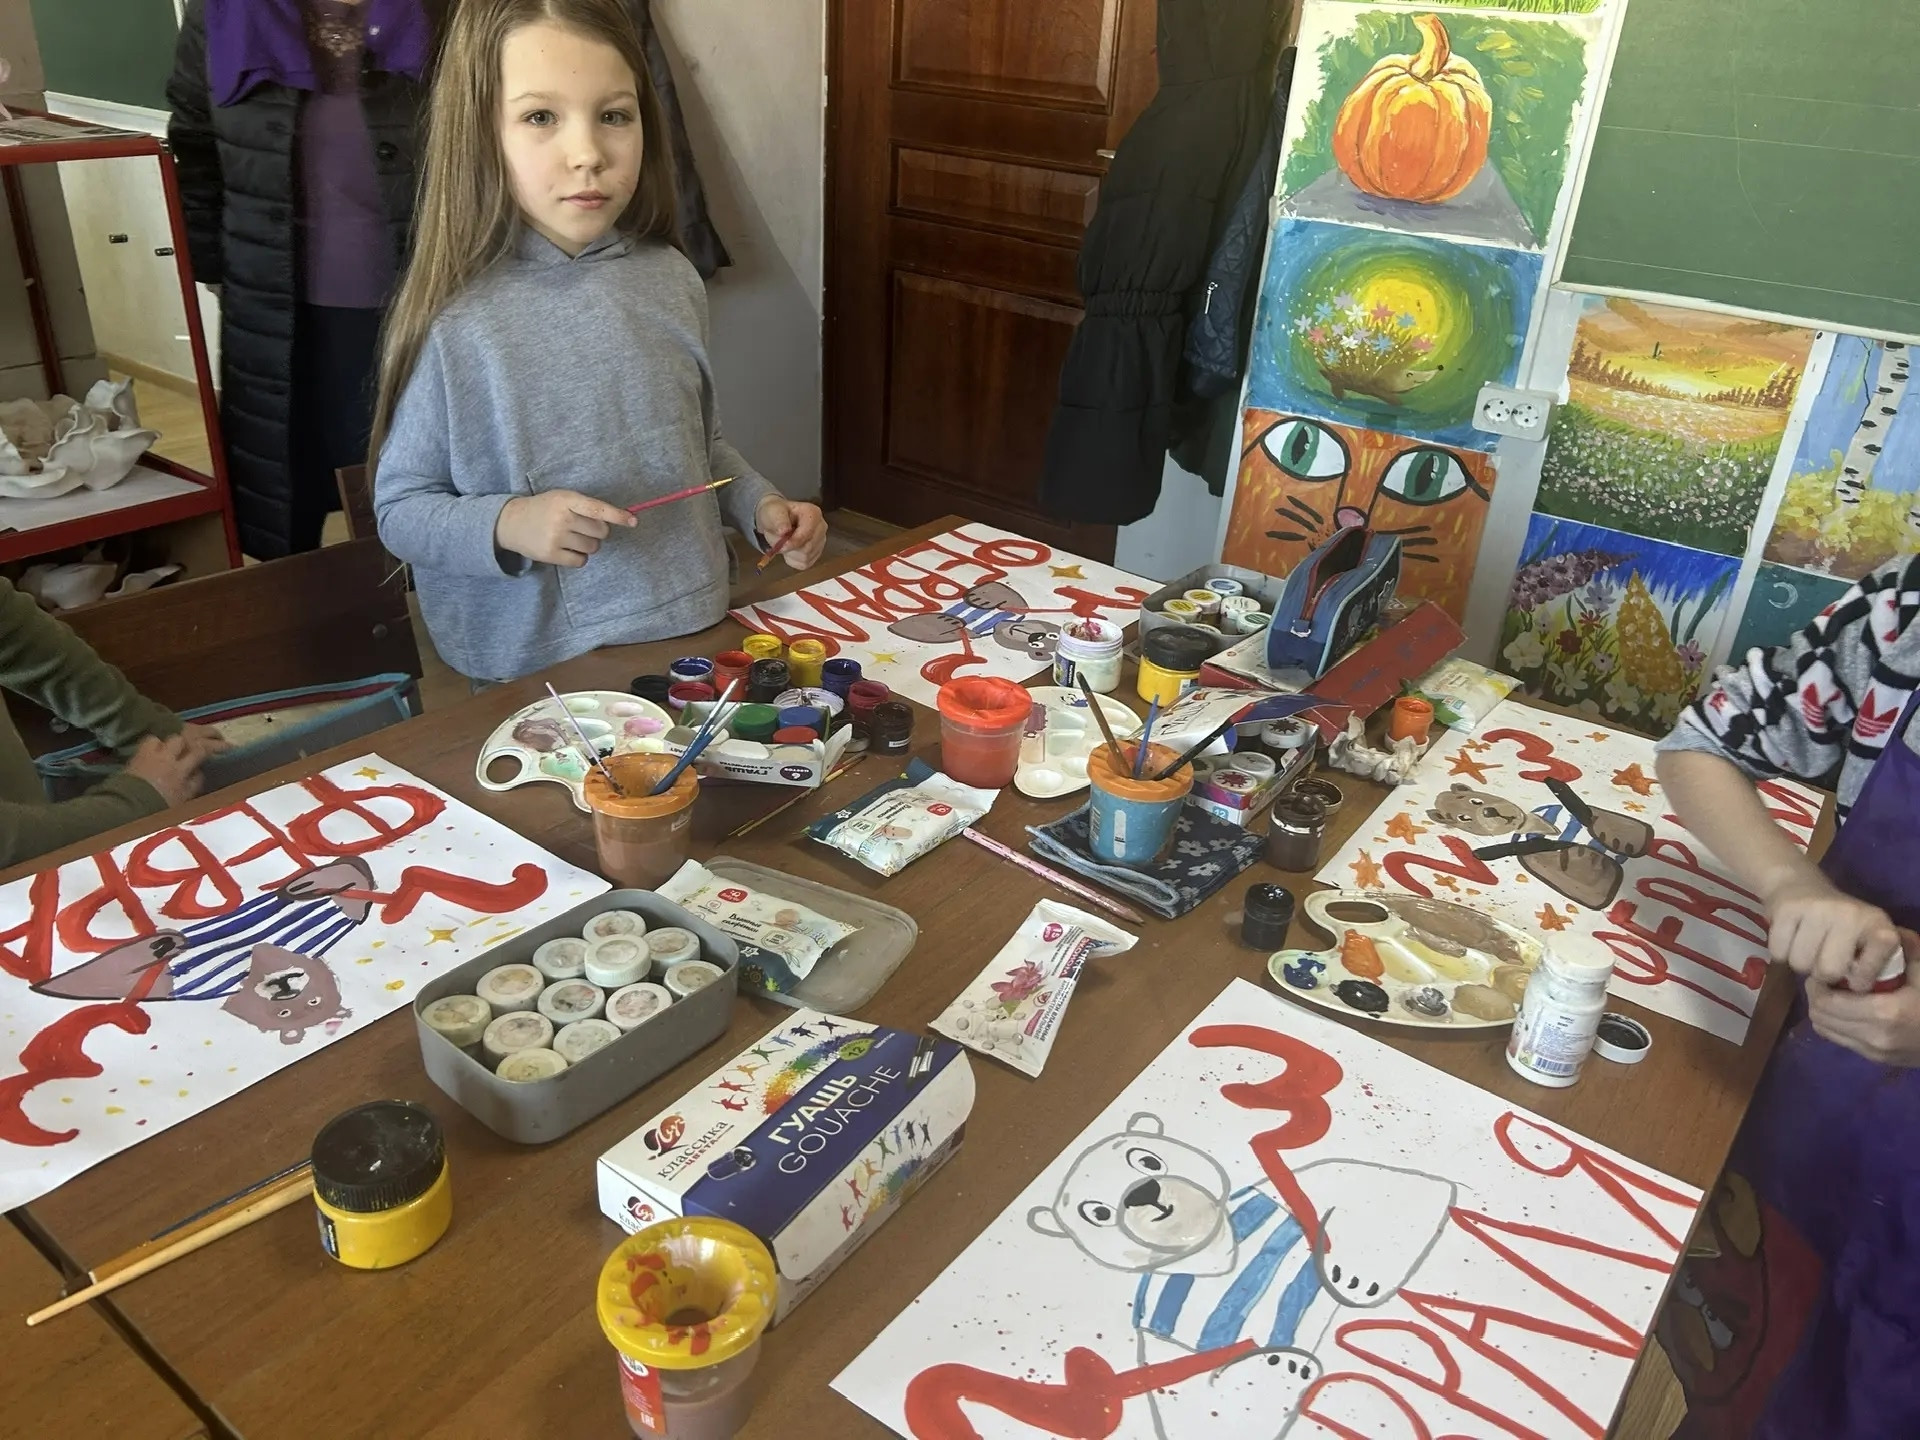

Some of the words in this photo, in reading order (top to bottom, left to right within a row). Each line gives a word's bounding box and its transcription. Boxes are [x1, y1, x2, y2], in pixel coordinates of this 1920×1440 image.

[725, 766, 769, 776] ГУАШЬ
[791, 772, 801, 780] 6
[1480, 727, 1583, 784] 3
[1382, 833, 1500, 899] 2
[848, 1046, 866, 1057] 12
[768, 1075, 858, 1145] ГУАШЬ
[778, 1065, 901, 1174] GOUACHE
[1188, 1024, 1345, 1180] 3
[658, 1121, 729, 1179] классика
